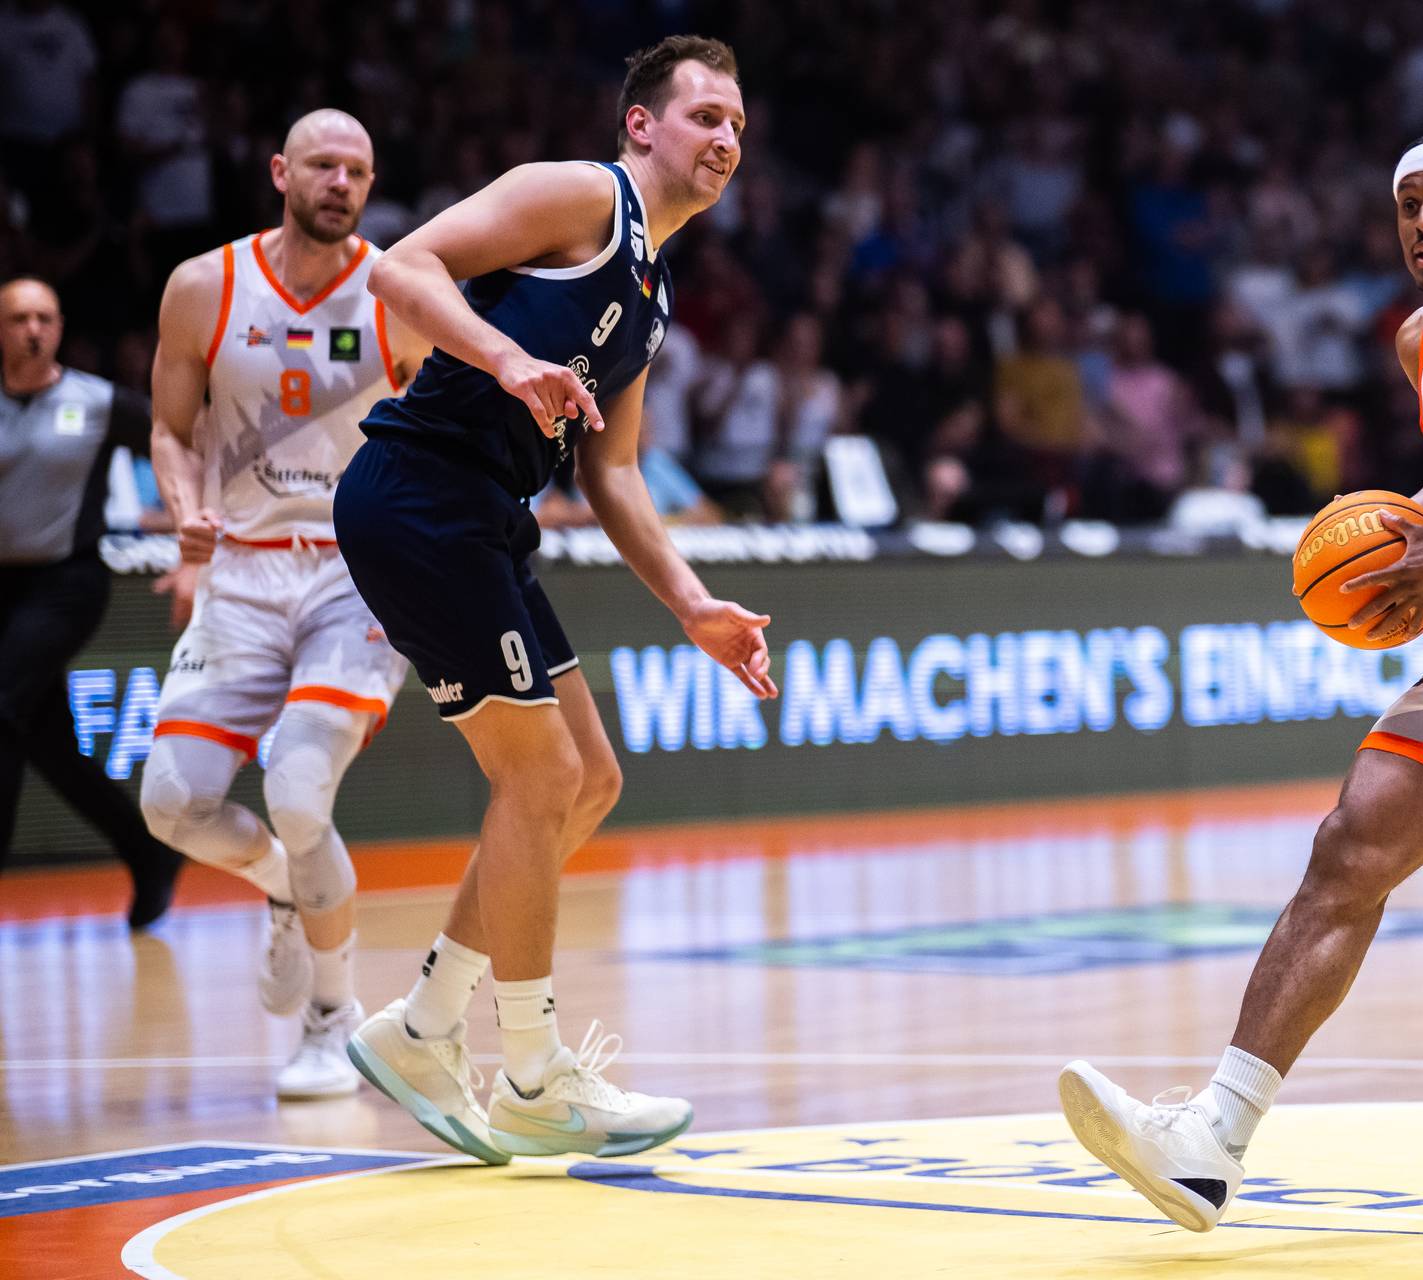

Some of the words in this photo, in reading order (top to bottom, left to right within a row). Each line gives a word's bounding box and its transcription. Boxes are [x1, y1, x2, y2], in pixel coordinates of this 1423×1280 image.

[591, 301, 622, 346] 9
[280, 368, 312, 417] 8
[1299, 509, 1385, 568] Wilson
[500, 630, 534, 692] 9
[609, 643, 769, 753] WIR
[779, 624, 1174, 745] MACHEN'S
[66, 667, 160, 780] FA
